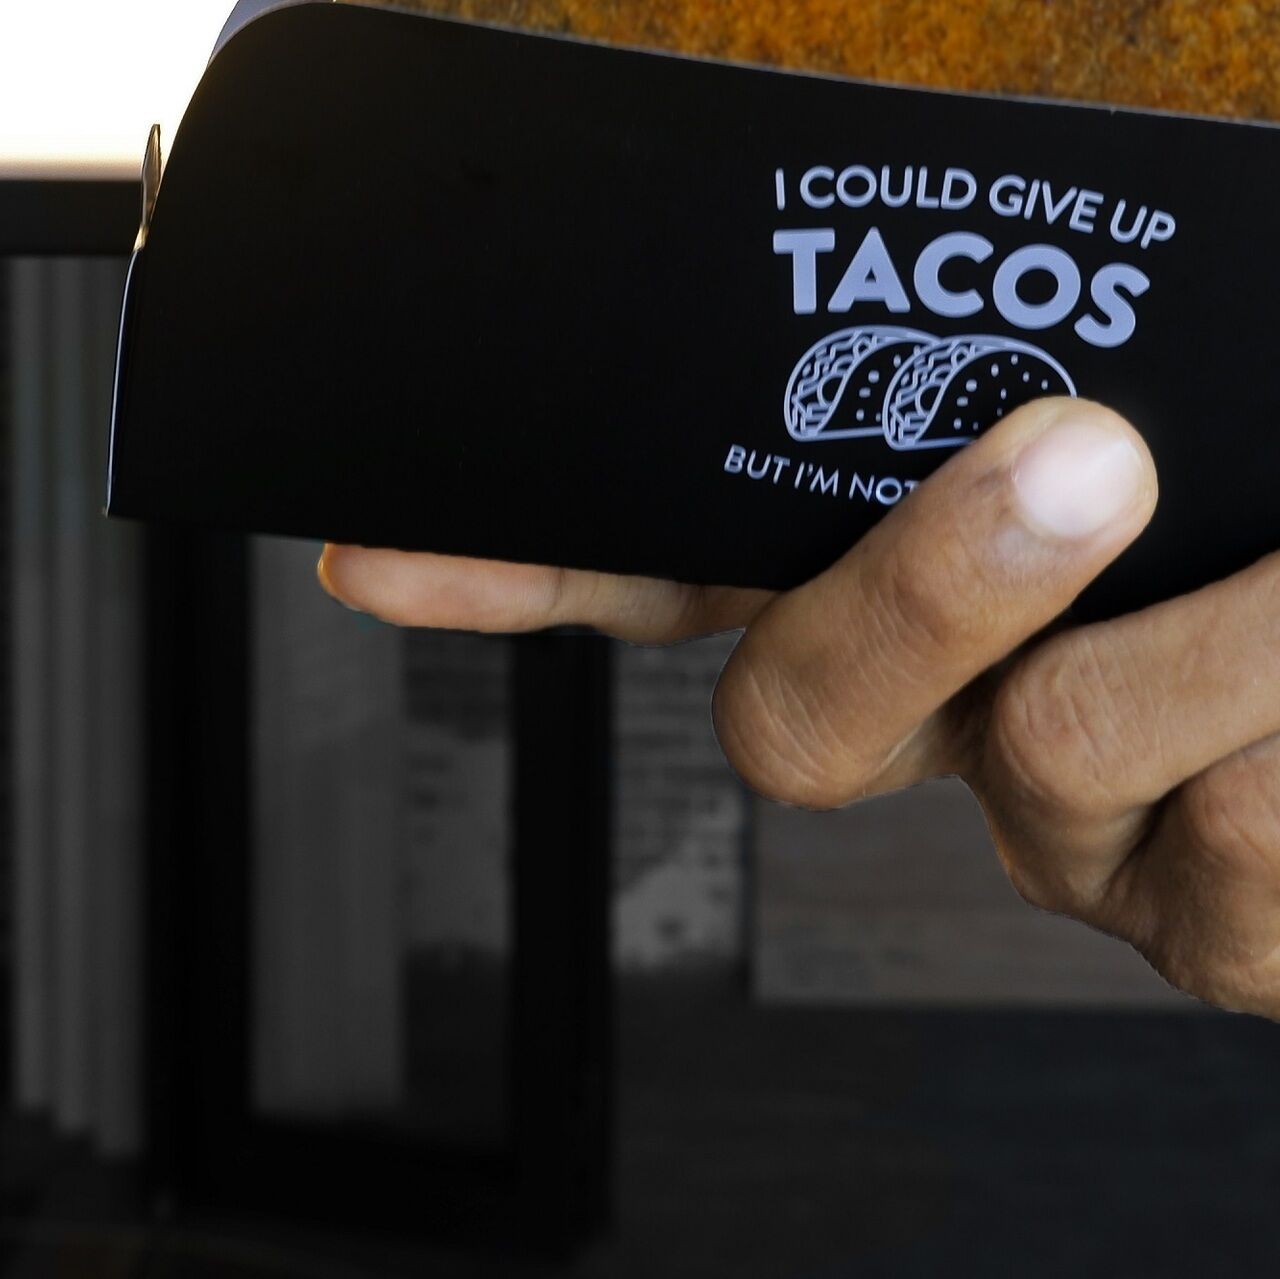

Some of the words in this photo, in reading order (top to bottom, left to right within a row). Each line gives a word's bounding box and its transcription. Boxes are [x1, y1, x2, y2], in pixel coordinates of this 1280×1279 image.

[775, 169, 786, 210] I
[799, 165, 978, 210] COULD
[988, 175, 1104, 233] GIVE
[1109, 200, 1176, 249] UP
[772, 227, 1150, 348] TACOS
[723, 444, 791, 484] BUT
[793, 462, 839, 497] I'M
